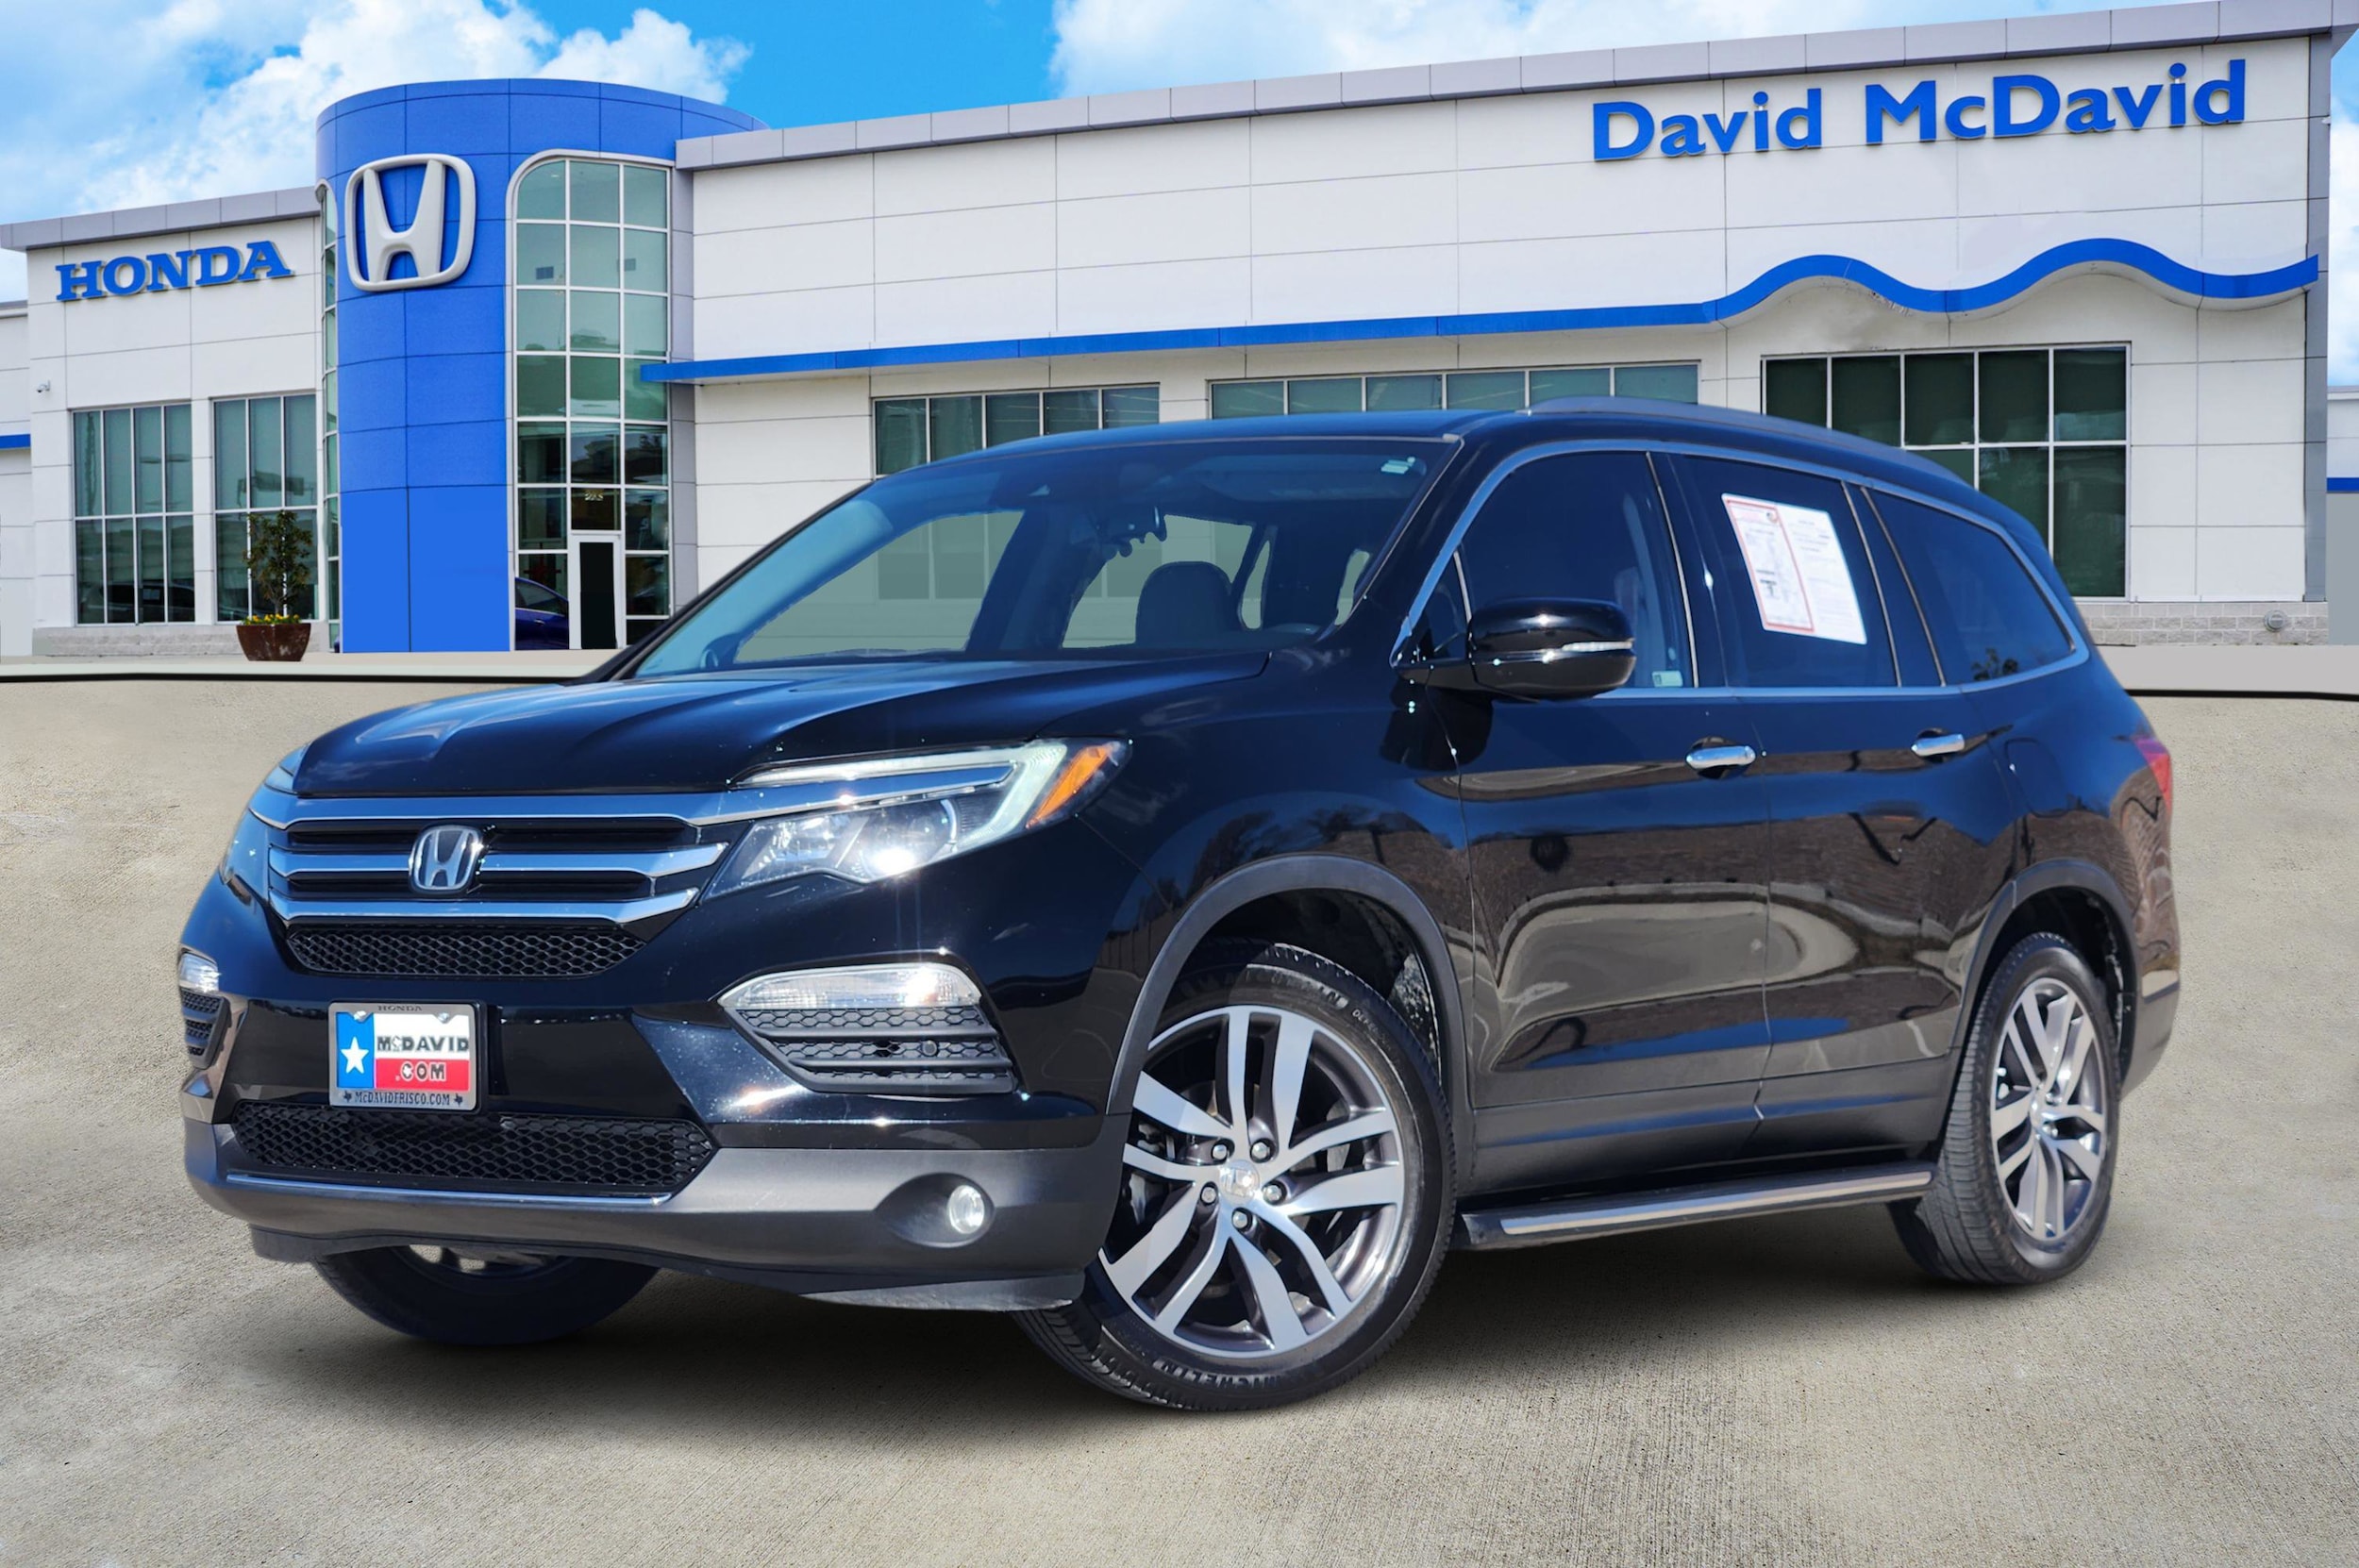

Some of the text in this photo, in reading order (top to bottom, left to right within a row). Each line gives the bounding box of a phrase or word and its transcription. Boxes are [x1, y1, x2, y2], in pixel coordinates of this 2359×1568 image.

[1593, 58, 2247, 161] David McDavid
[55, 241, 293, 301] HONDA
[395, 1061, 446, 1082] .COM
